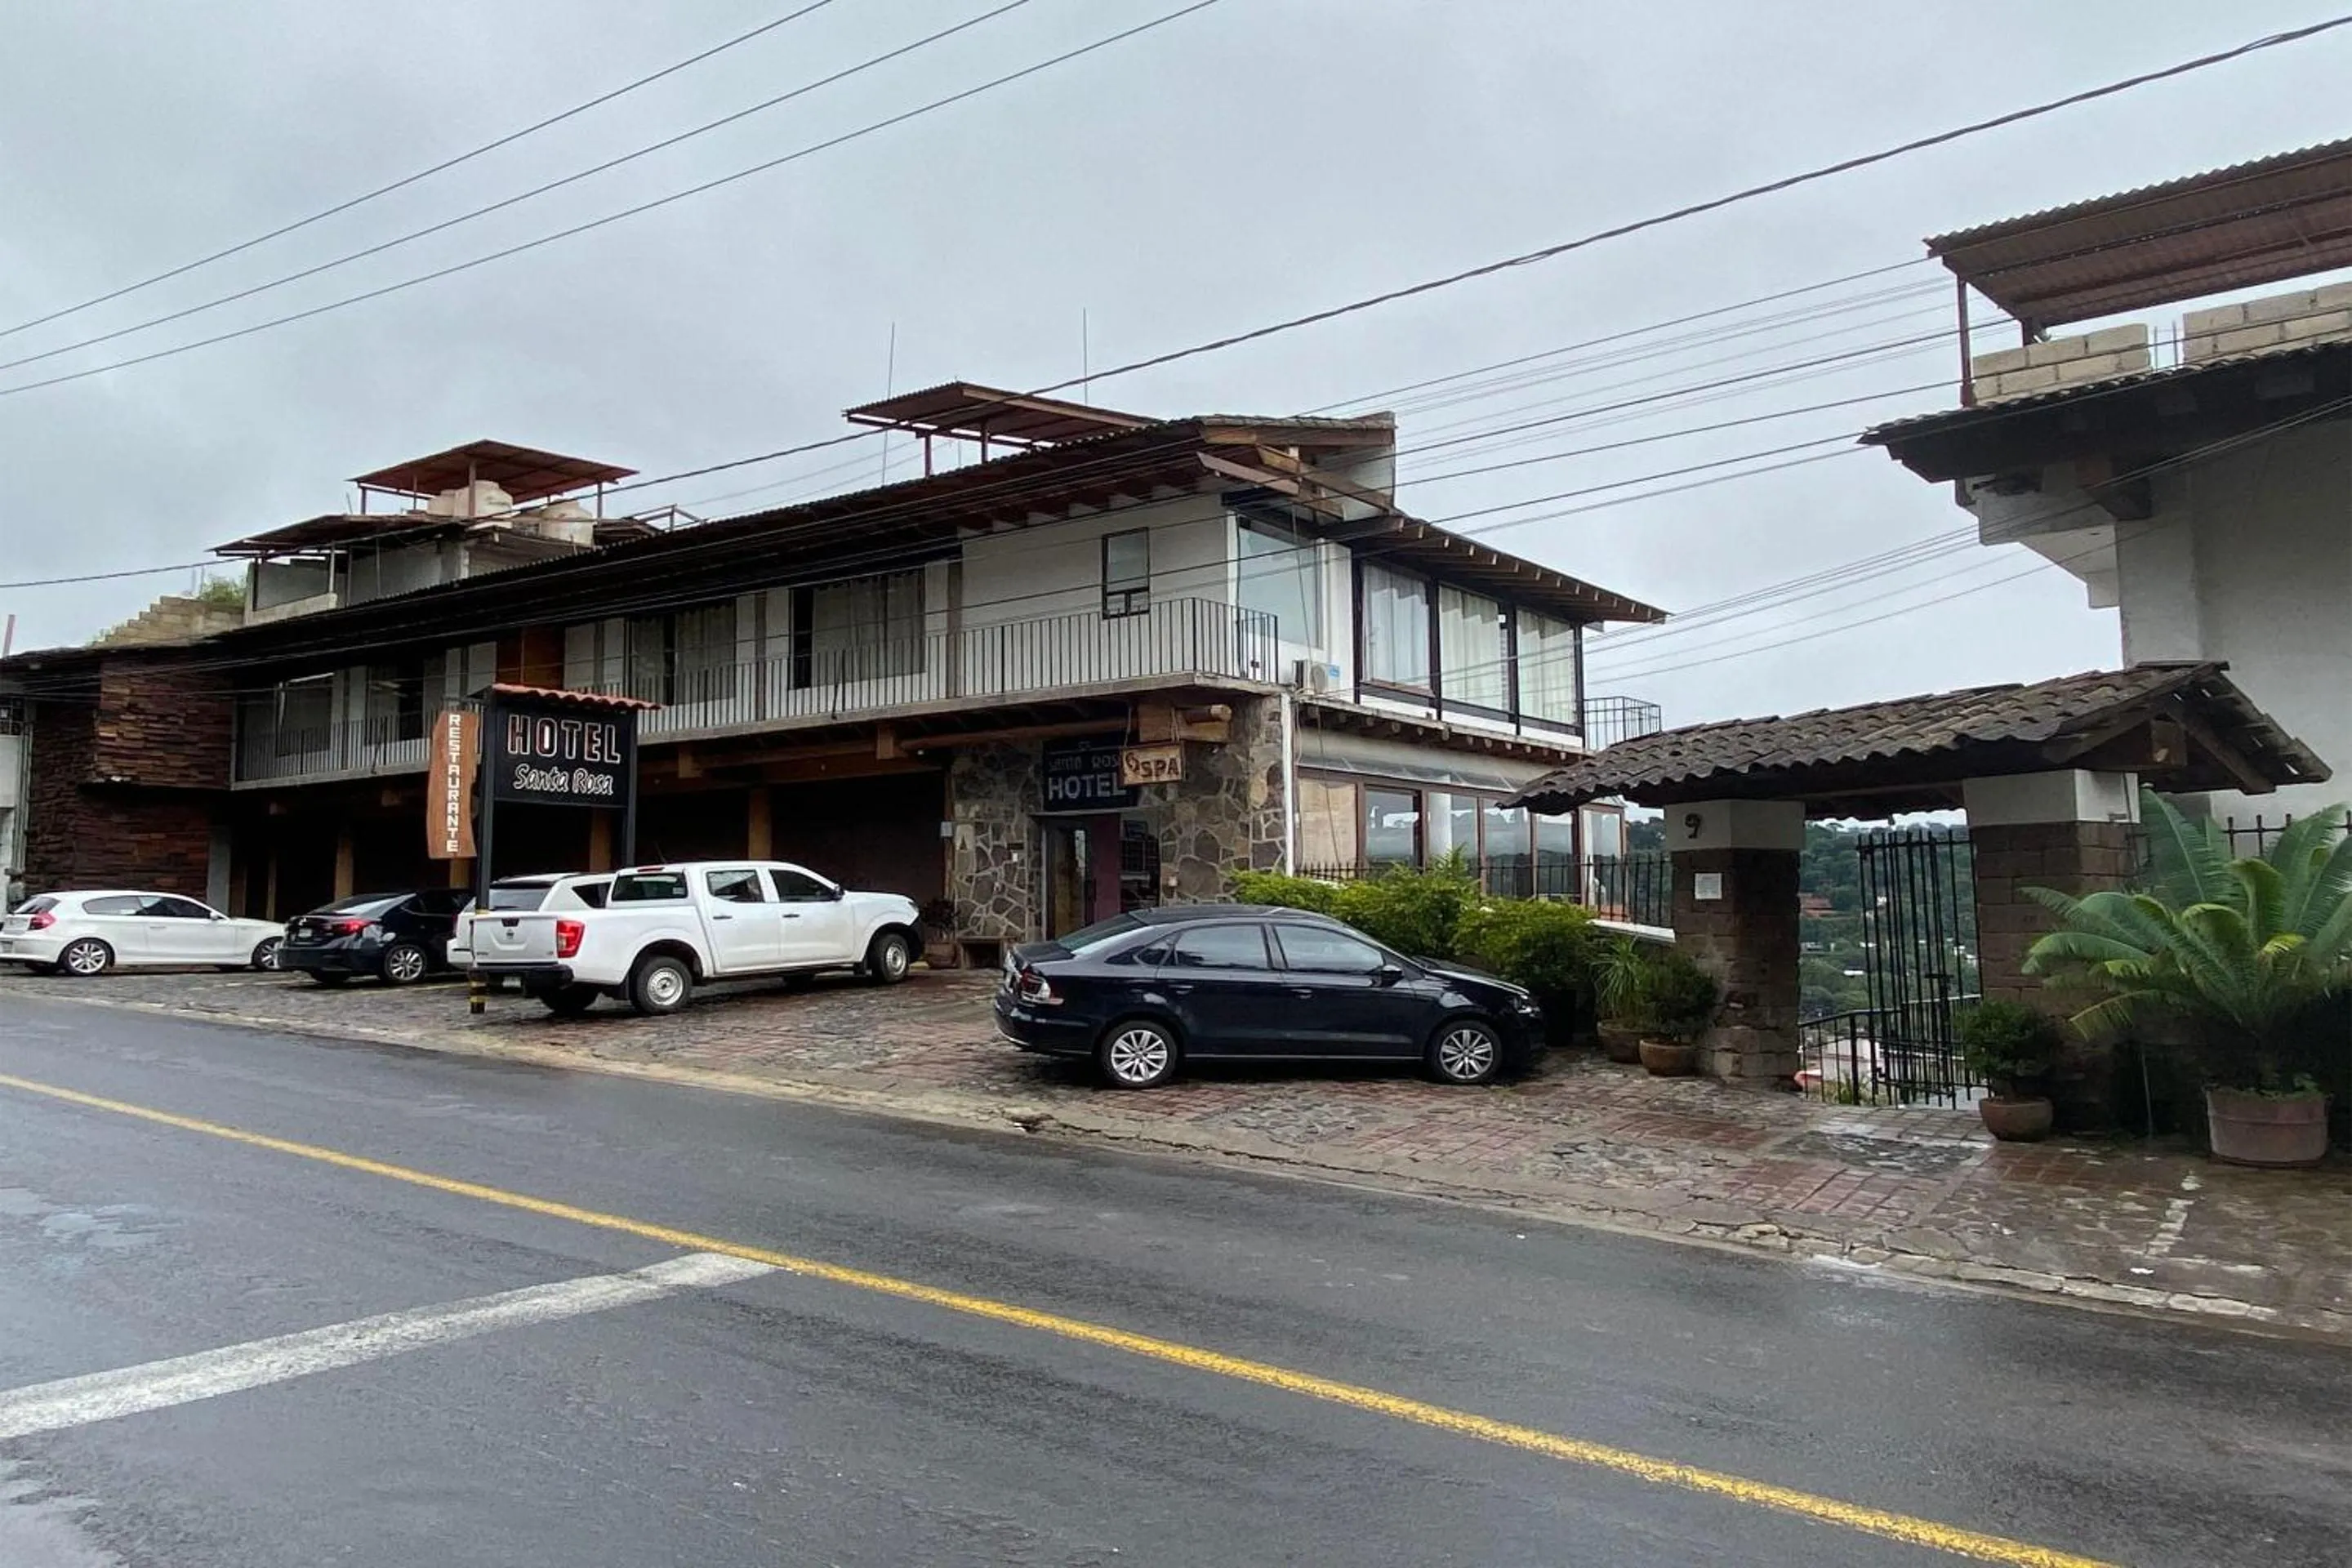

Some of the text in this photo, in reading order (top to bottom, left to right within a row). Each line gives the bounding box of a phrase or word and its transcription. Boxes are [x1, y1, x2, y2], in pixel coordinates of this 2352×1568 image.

[507, 714, 621, 764] HOTEL
[1091, 754, 1120, 768] ROS
[1141, 758, 1180, 777] SPA
[448, 714, 461, 852] RESTAURANTE
[513, 764, 613, 795] Santa Rosa
[1048, 773, 1127, 801] HOTEL
[1685, 813, 1701, 839] 9
